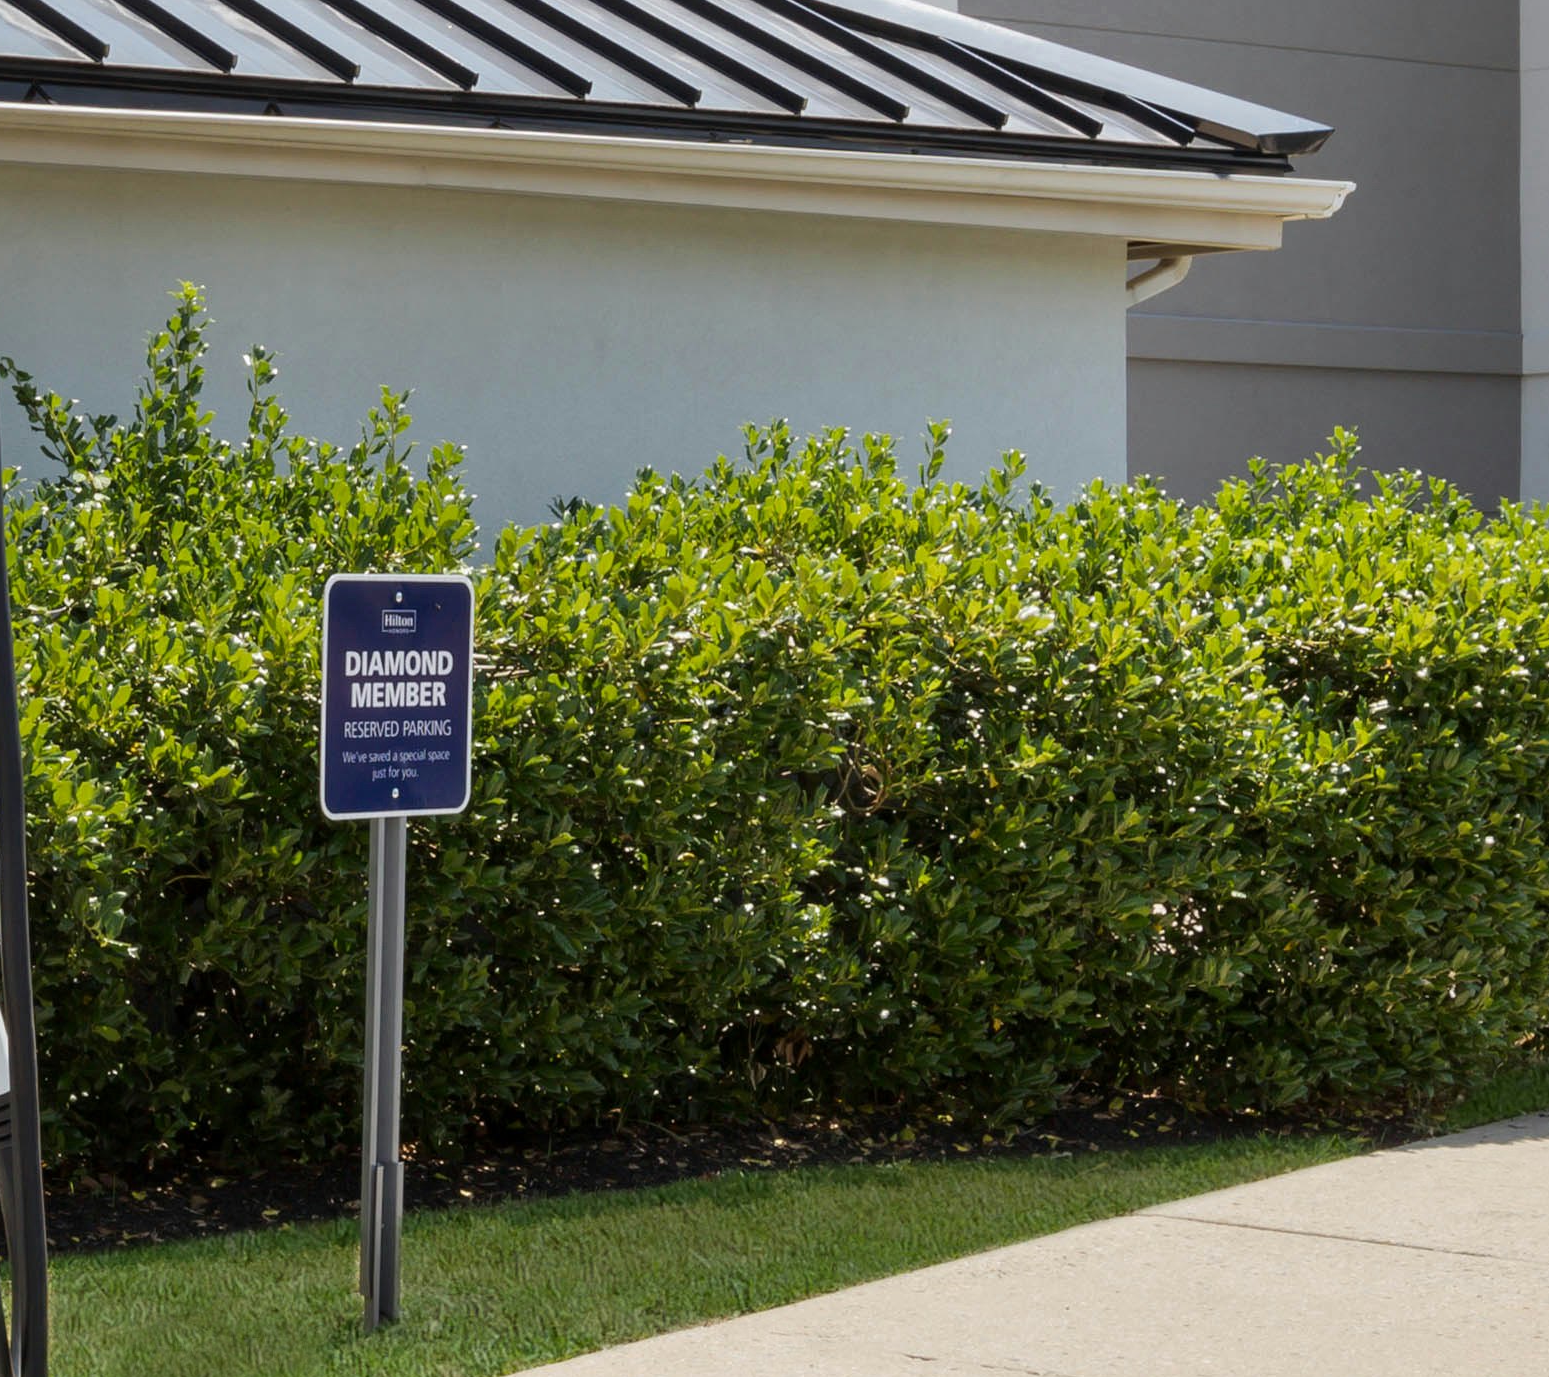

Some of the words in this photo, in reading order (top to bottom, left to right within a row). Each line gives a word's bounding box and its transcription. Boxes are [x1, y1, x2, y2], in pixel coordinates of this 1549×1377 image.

[384, 613, 414, 627] Hilton
[345, 650, 454, 677] DIAMOND
[350, 682, 447, 708] MEMBER
[344, 720, 400, 738] RESERVED
[402, 719, 452, 737] PARKING
[342, 750, 368, 763] We've
[368, 749, 391, 763] saved
[392, 751, 398, 762] a
[399, 748, 427, 763] special
[427, 749, 451, 763] space
[371, 767, 387, 782] just
[388, 765, 400, 778] for
[401, 767, 419, 781] you.
